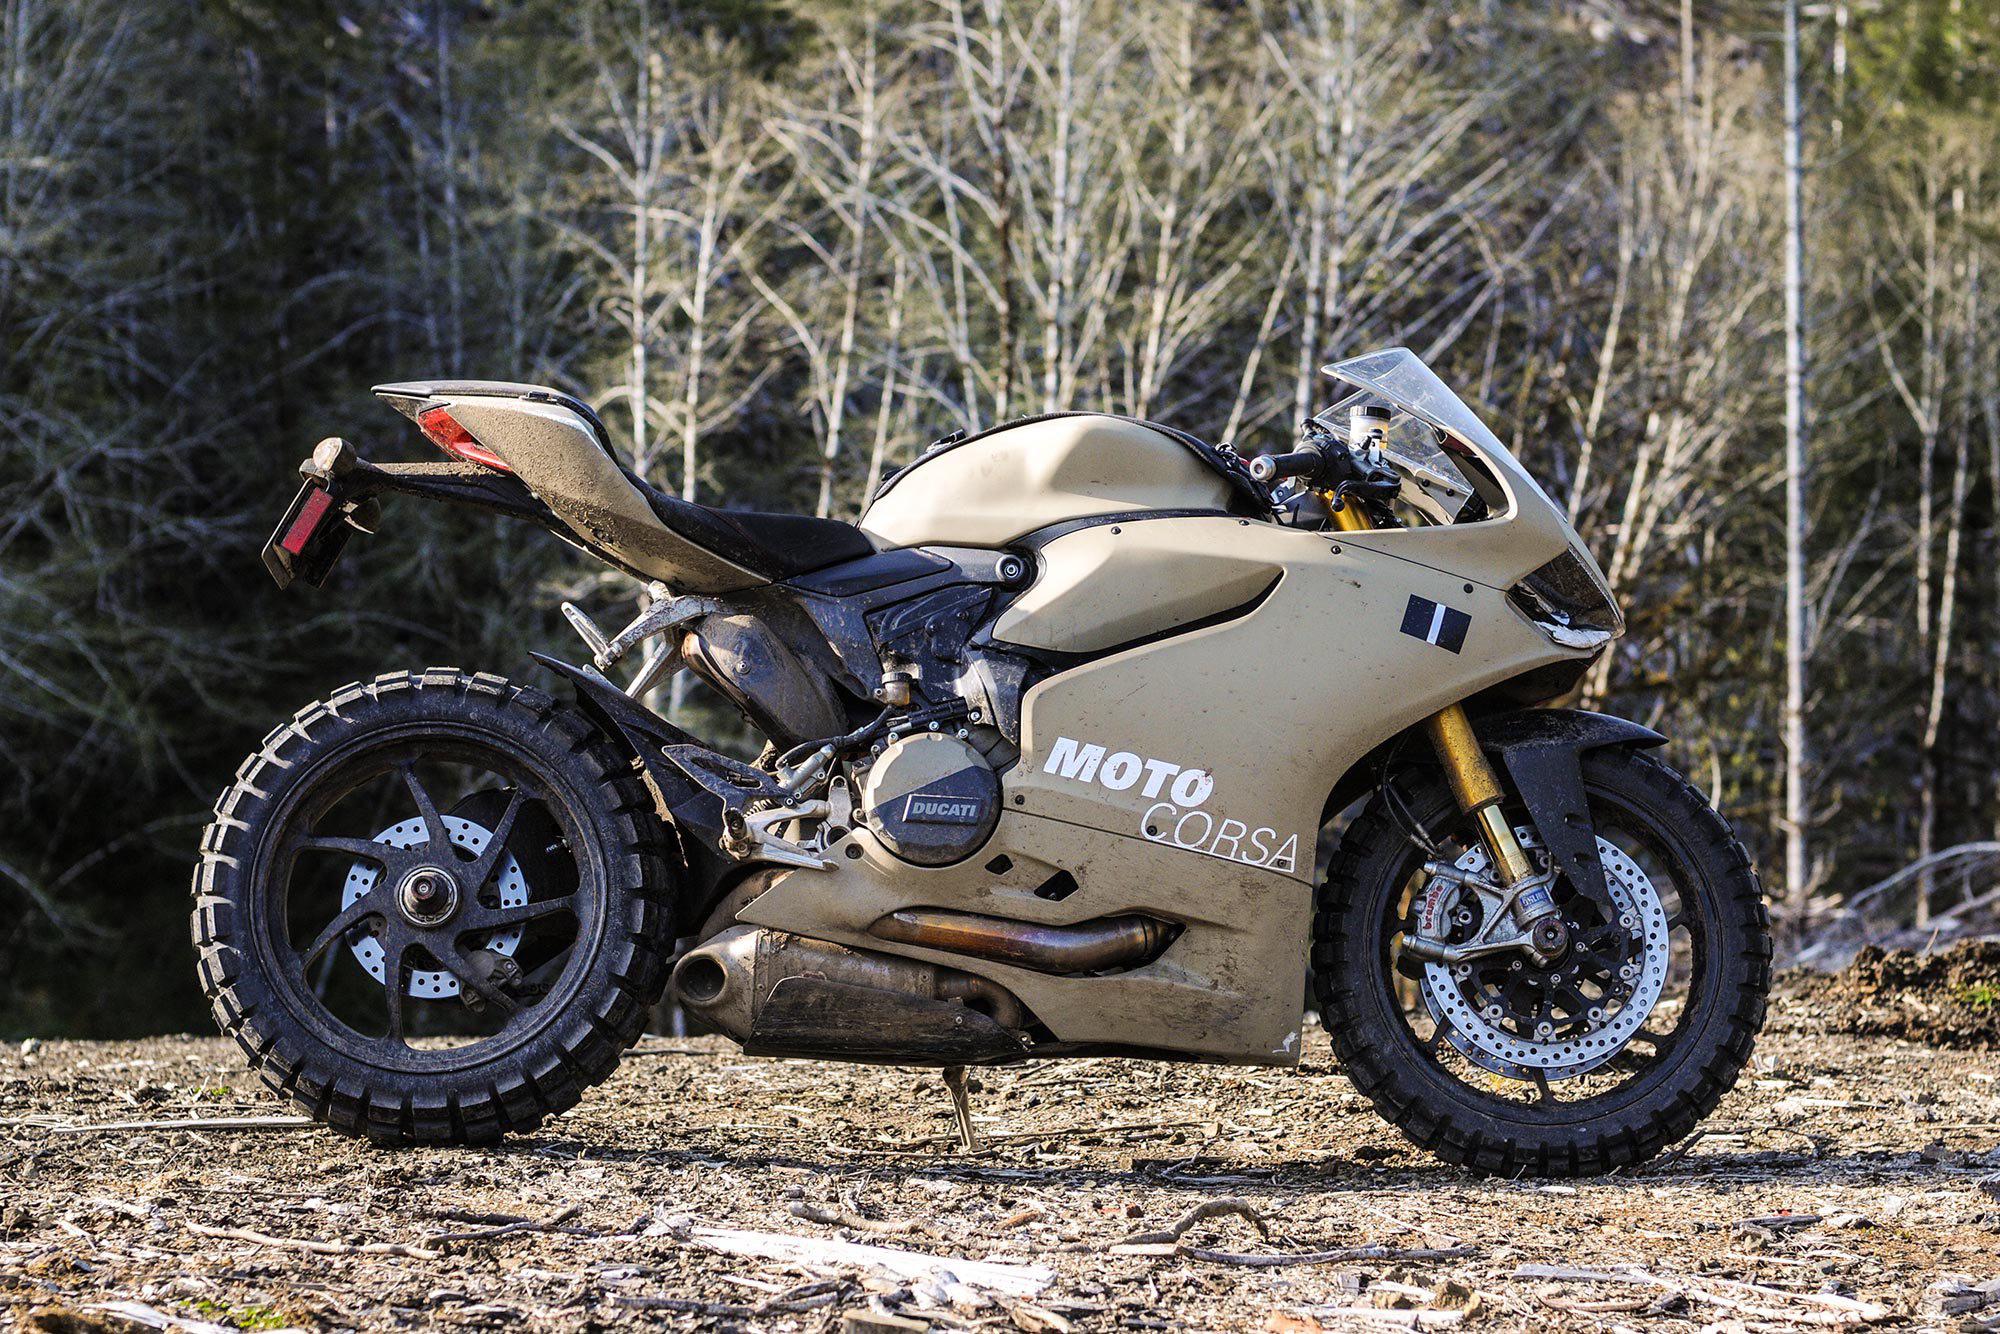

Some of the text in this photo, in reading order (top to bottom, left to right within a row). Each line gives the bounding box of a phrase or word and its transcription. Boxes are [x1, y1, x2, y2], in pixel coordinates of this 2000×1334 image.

[1043, 736, 1214, 807] MOTO
[912, 802, 977, 817] DUCATI
[1140, 802, 1298, 873] CORSA
